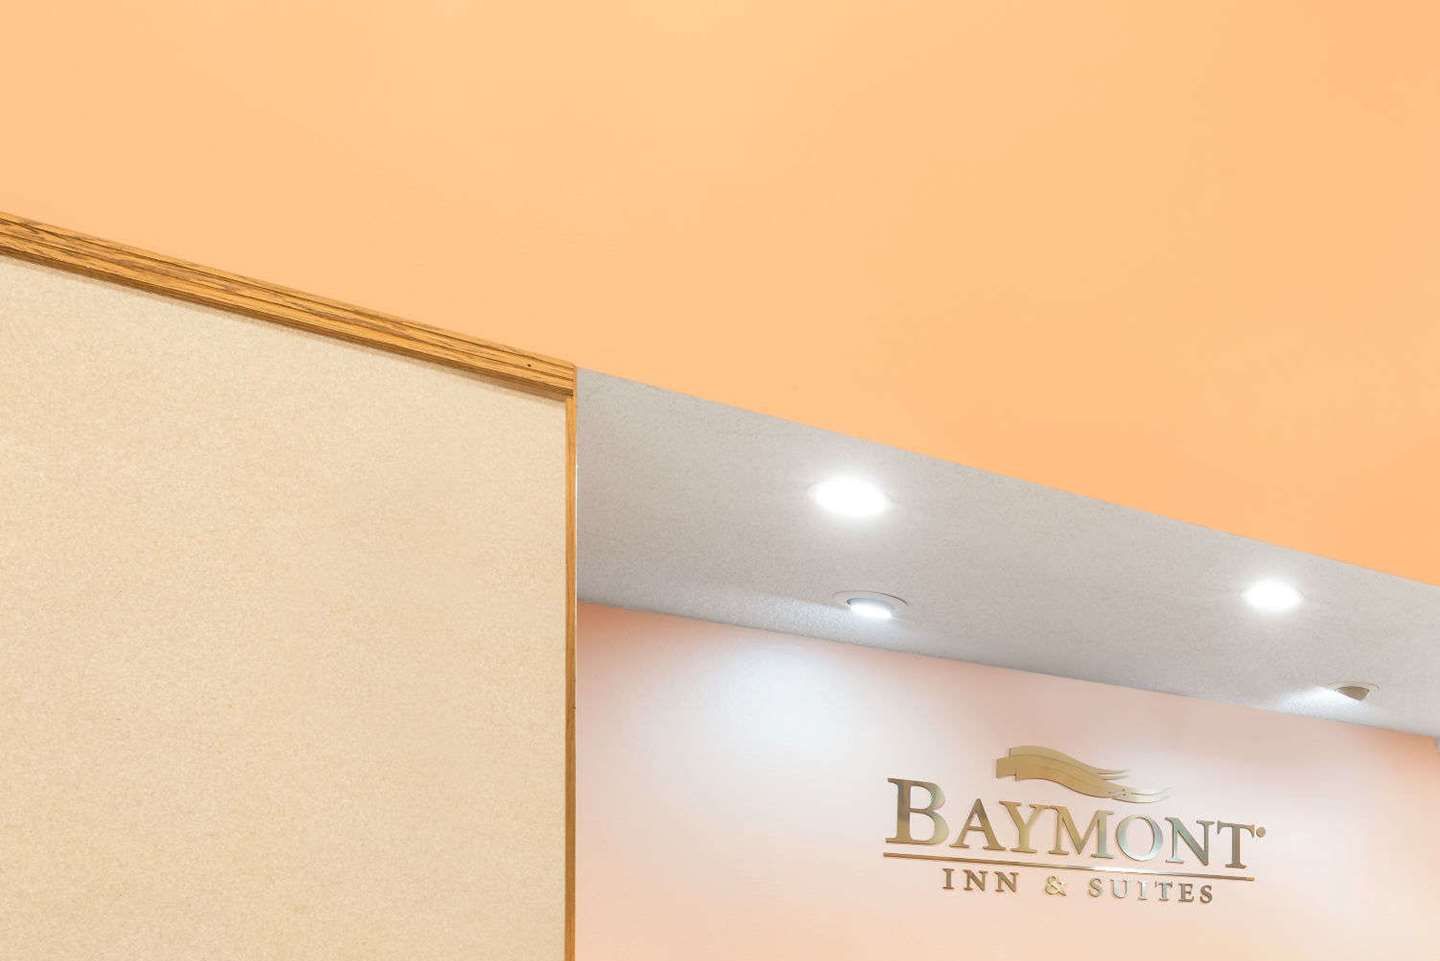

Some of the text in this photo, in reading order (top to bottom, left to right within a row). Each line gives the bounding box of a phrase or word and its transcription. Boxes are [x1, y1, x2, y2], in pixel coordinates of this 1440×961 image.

[885, 777, 1255, 869] BAYMONT
[942, 867, 1213, 903] INN & SUITES
